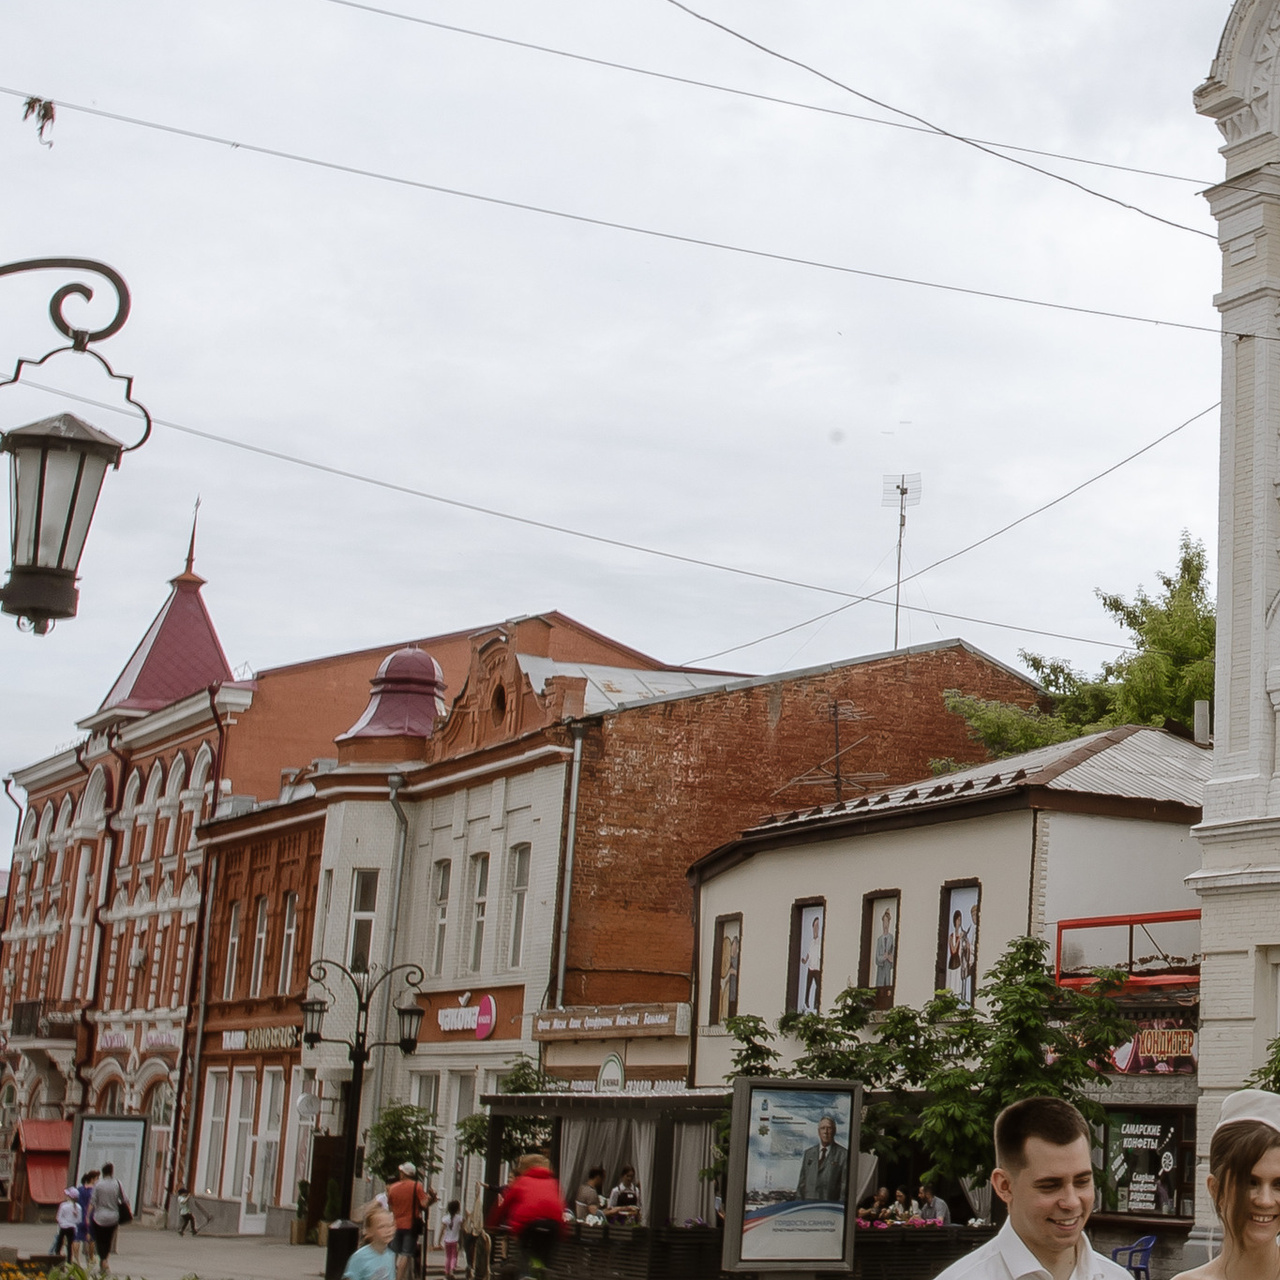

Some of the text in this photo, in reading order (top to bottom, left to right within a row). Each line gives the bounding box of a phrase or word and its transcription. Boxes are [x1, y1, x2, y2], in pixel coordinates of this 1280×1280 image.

[1138, 1029, 1195, 1060] КОНДИТЕР
[1121, 1123, 1162, 1136] САМАРСКИЕ
[1122, 1138, 1159, 1150] КОНФЕТЫ
